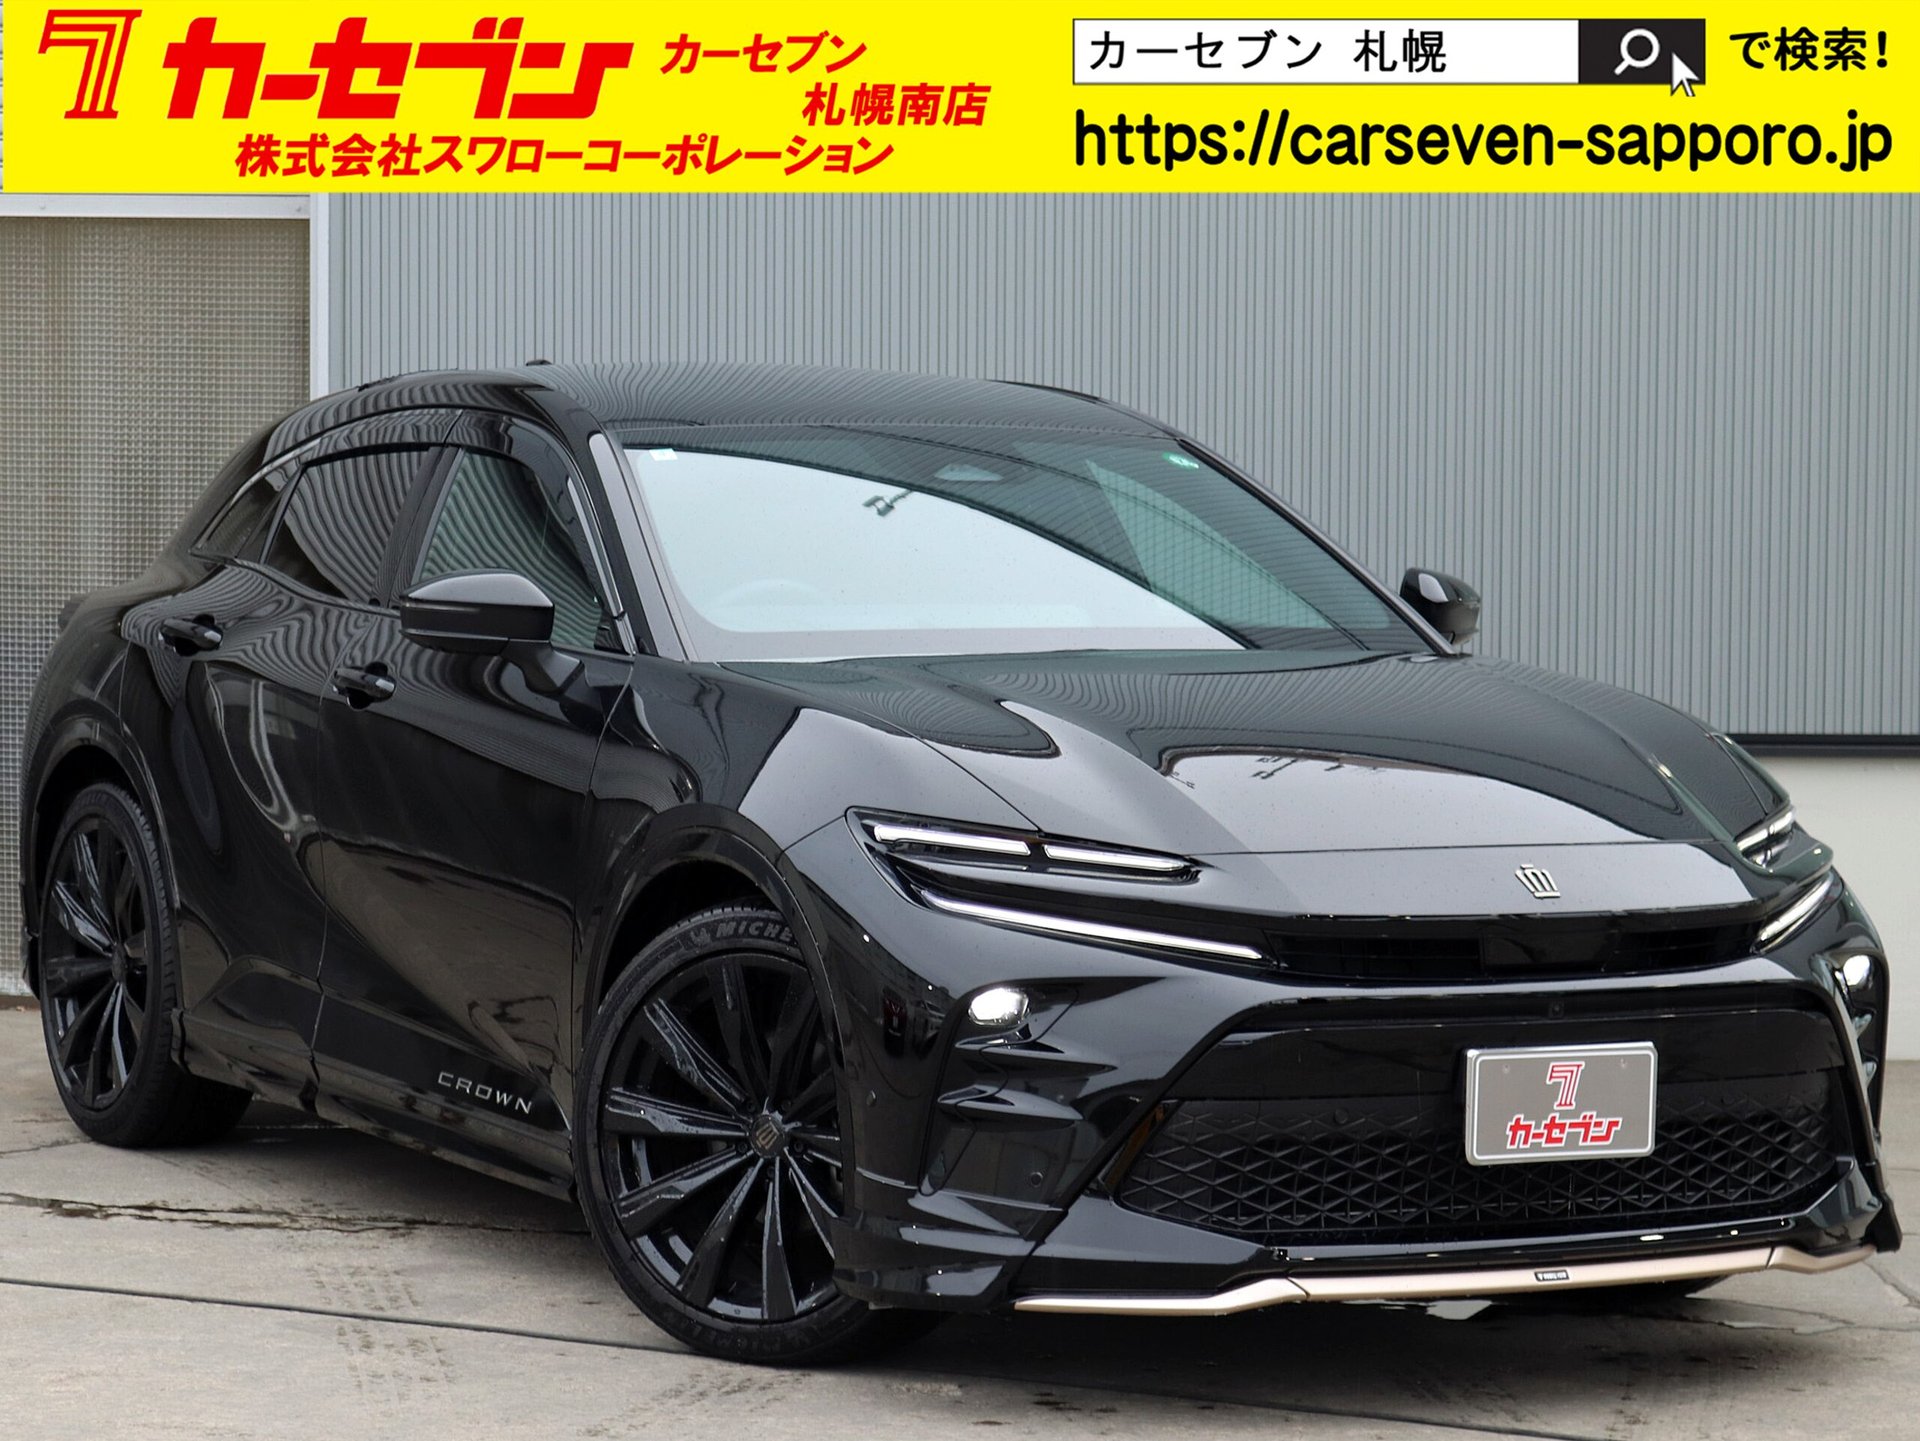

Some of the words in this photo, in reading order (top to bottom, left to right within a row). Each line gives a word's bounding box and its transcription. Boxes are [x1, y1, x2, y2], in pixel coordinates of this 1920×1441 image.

[437, 1071, 532, 1115] CROWN
[1508, 1113, 1621, 1147] カーセブン
